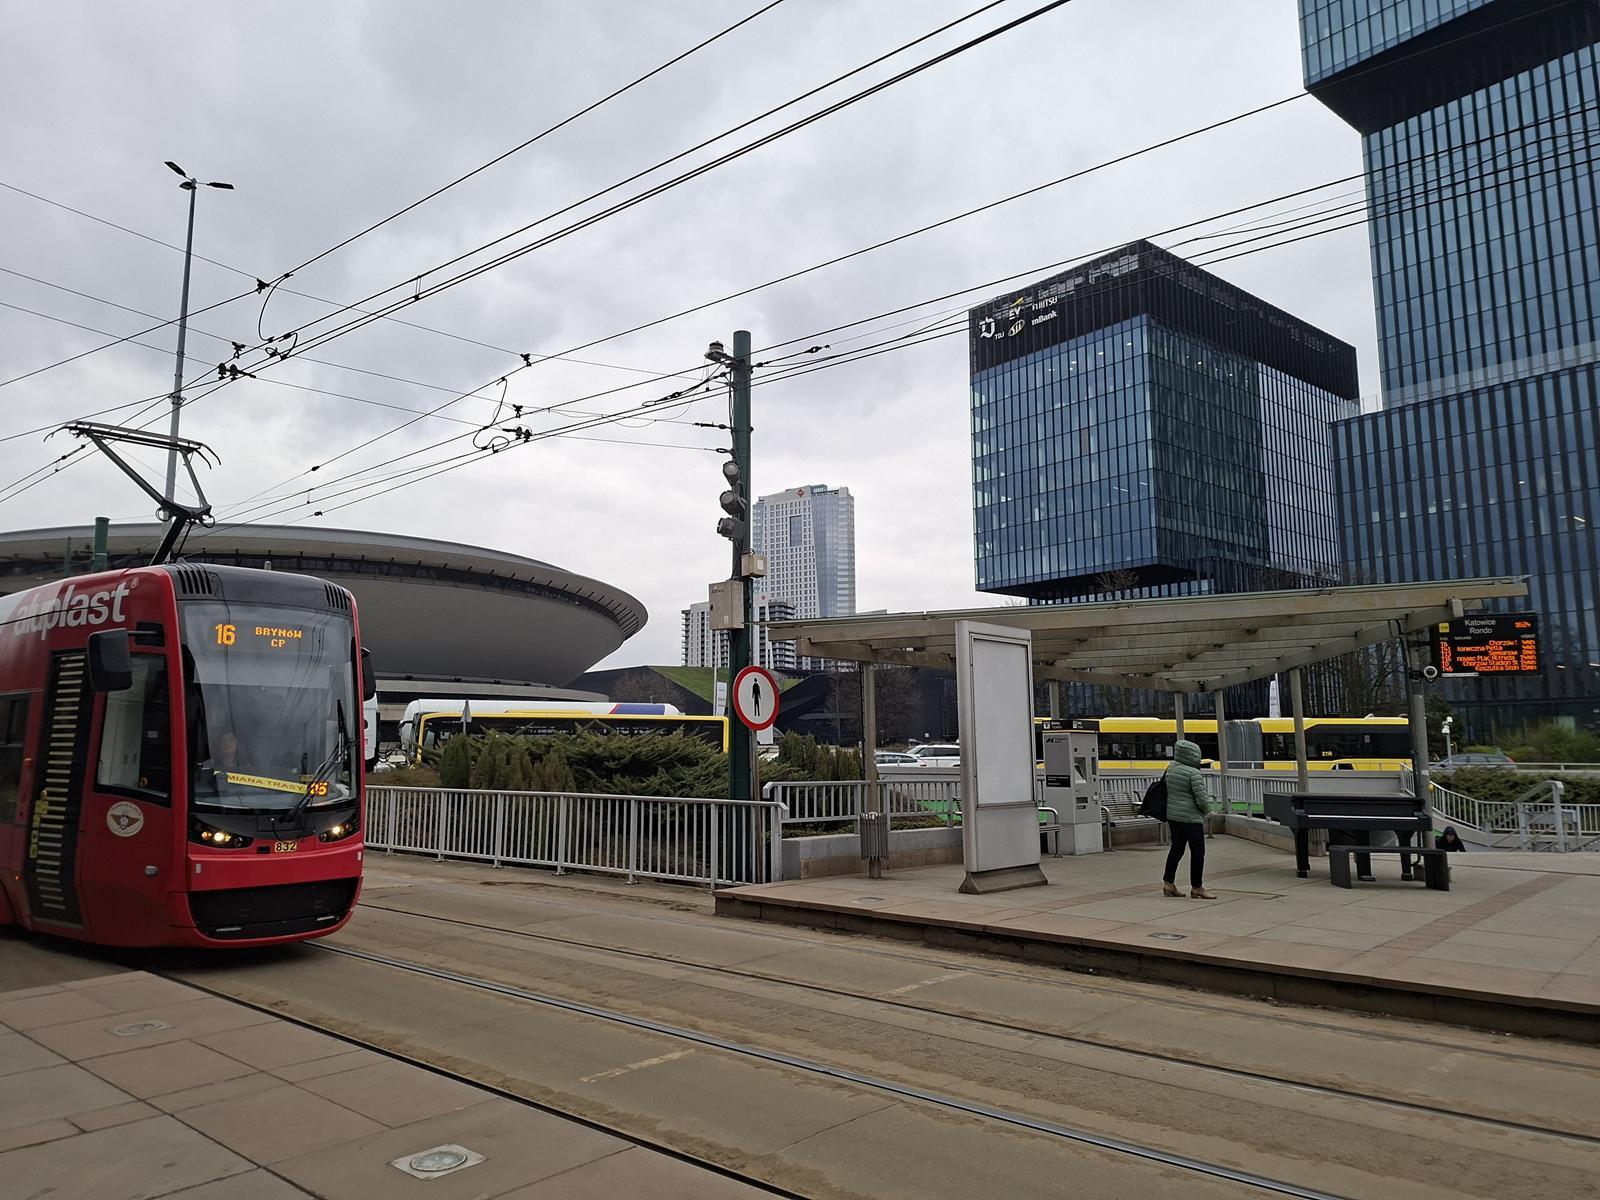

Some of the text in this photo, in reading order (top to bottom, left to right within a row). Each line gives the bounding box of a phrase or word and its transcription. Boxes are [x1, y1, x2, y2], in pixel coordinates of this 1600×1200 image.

[1032, 296, 1058, 311] FUJITSU
[1031, 310, 1057, 326] mBank
[994, 331, 1005, 340] TDJ
[215, 623, 236, 645] 16
[270, 638, 286, 647] CP
[227, 774, 304, 792] MIANA TRASY
[276, 842, 297, 851] 832
